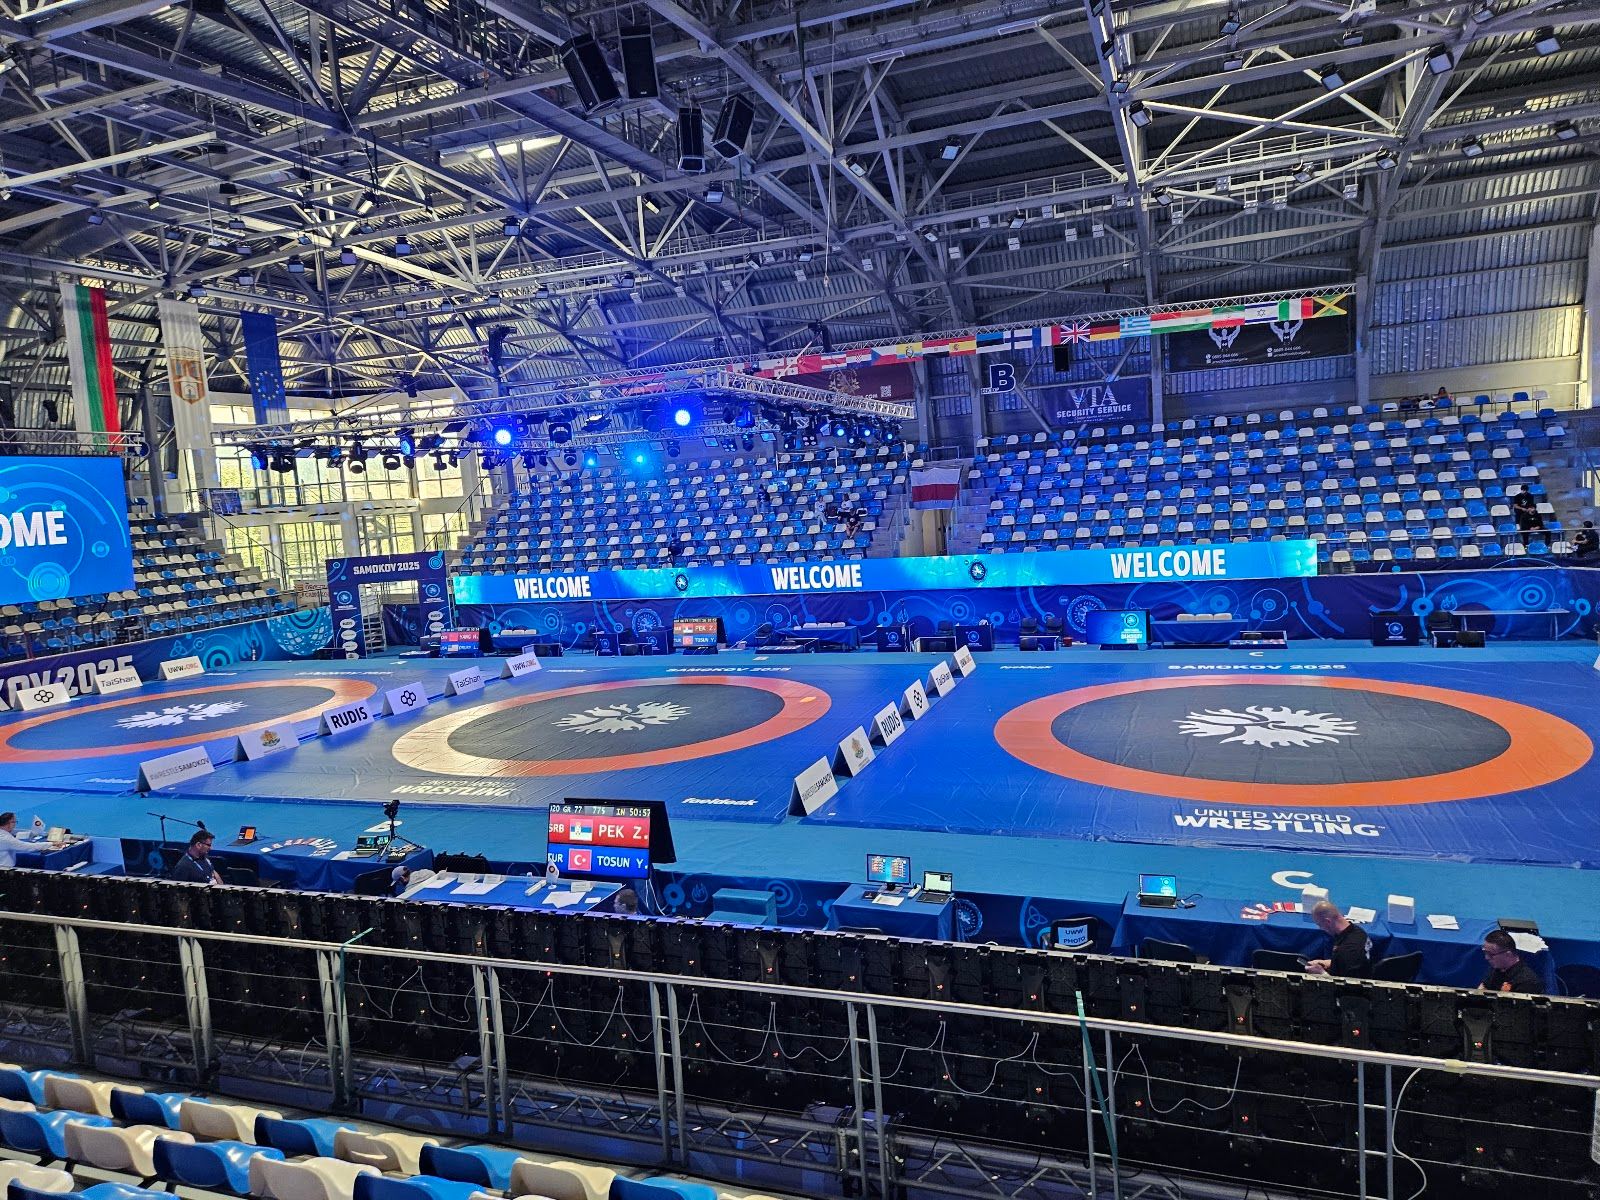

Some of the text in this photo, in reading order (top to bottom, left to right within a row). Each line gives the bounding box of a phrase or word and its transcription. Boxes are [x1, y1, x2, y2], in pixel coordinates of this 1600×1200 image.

[1056, 407, 1095, 418] SECURITY
[1097, 404, 1132, 414] SERVICE
[353, 561, 420, 575] SAMOKOV 2025
[1110, 549, 1226, 579] WELCOME
[771, 564, 862, 590] WELCOME
[513, 575, 591, 600] WELCOME
[167, 662, 199, 674] UWW.ORG
[100, 675, 137, 688] TaiShan
[455, 674, 482, 689] TaiShan
[330, 706, 368, 729] RUDIS
[881, 710, 901, 738] RUDIS
[592, 806, 606, 814] 775
[1195, 808, 1351, 823] UNITED WORLD
[549, 824, 649, 840] SRB PEK Z.
[597, 855, 630, 868] TOSUN
[636, 858, 648, 870] Y.
[1063, 936, 1086, 944] PHOTO
